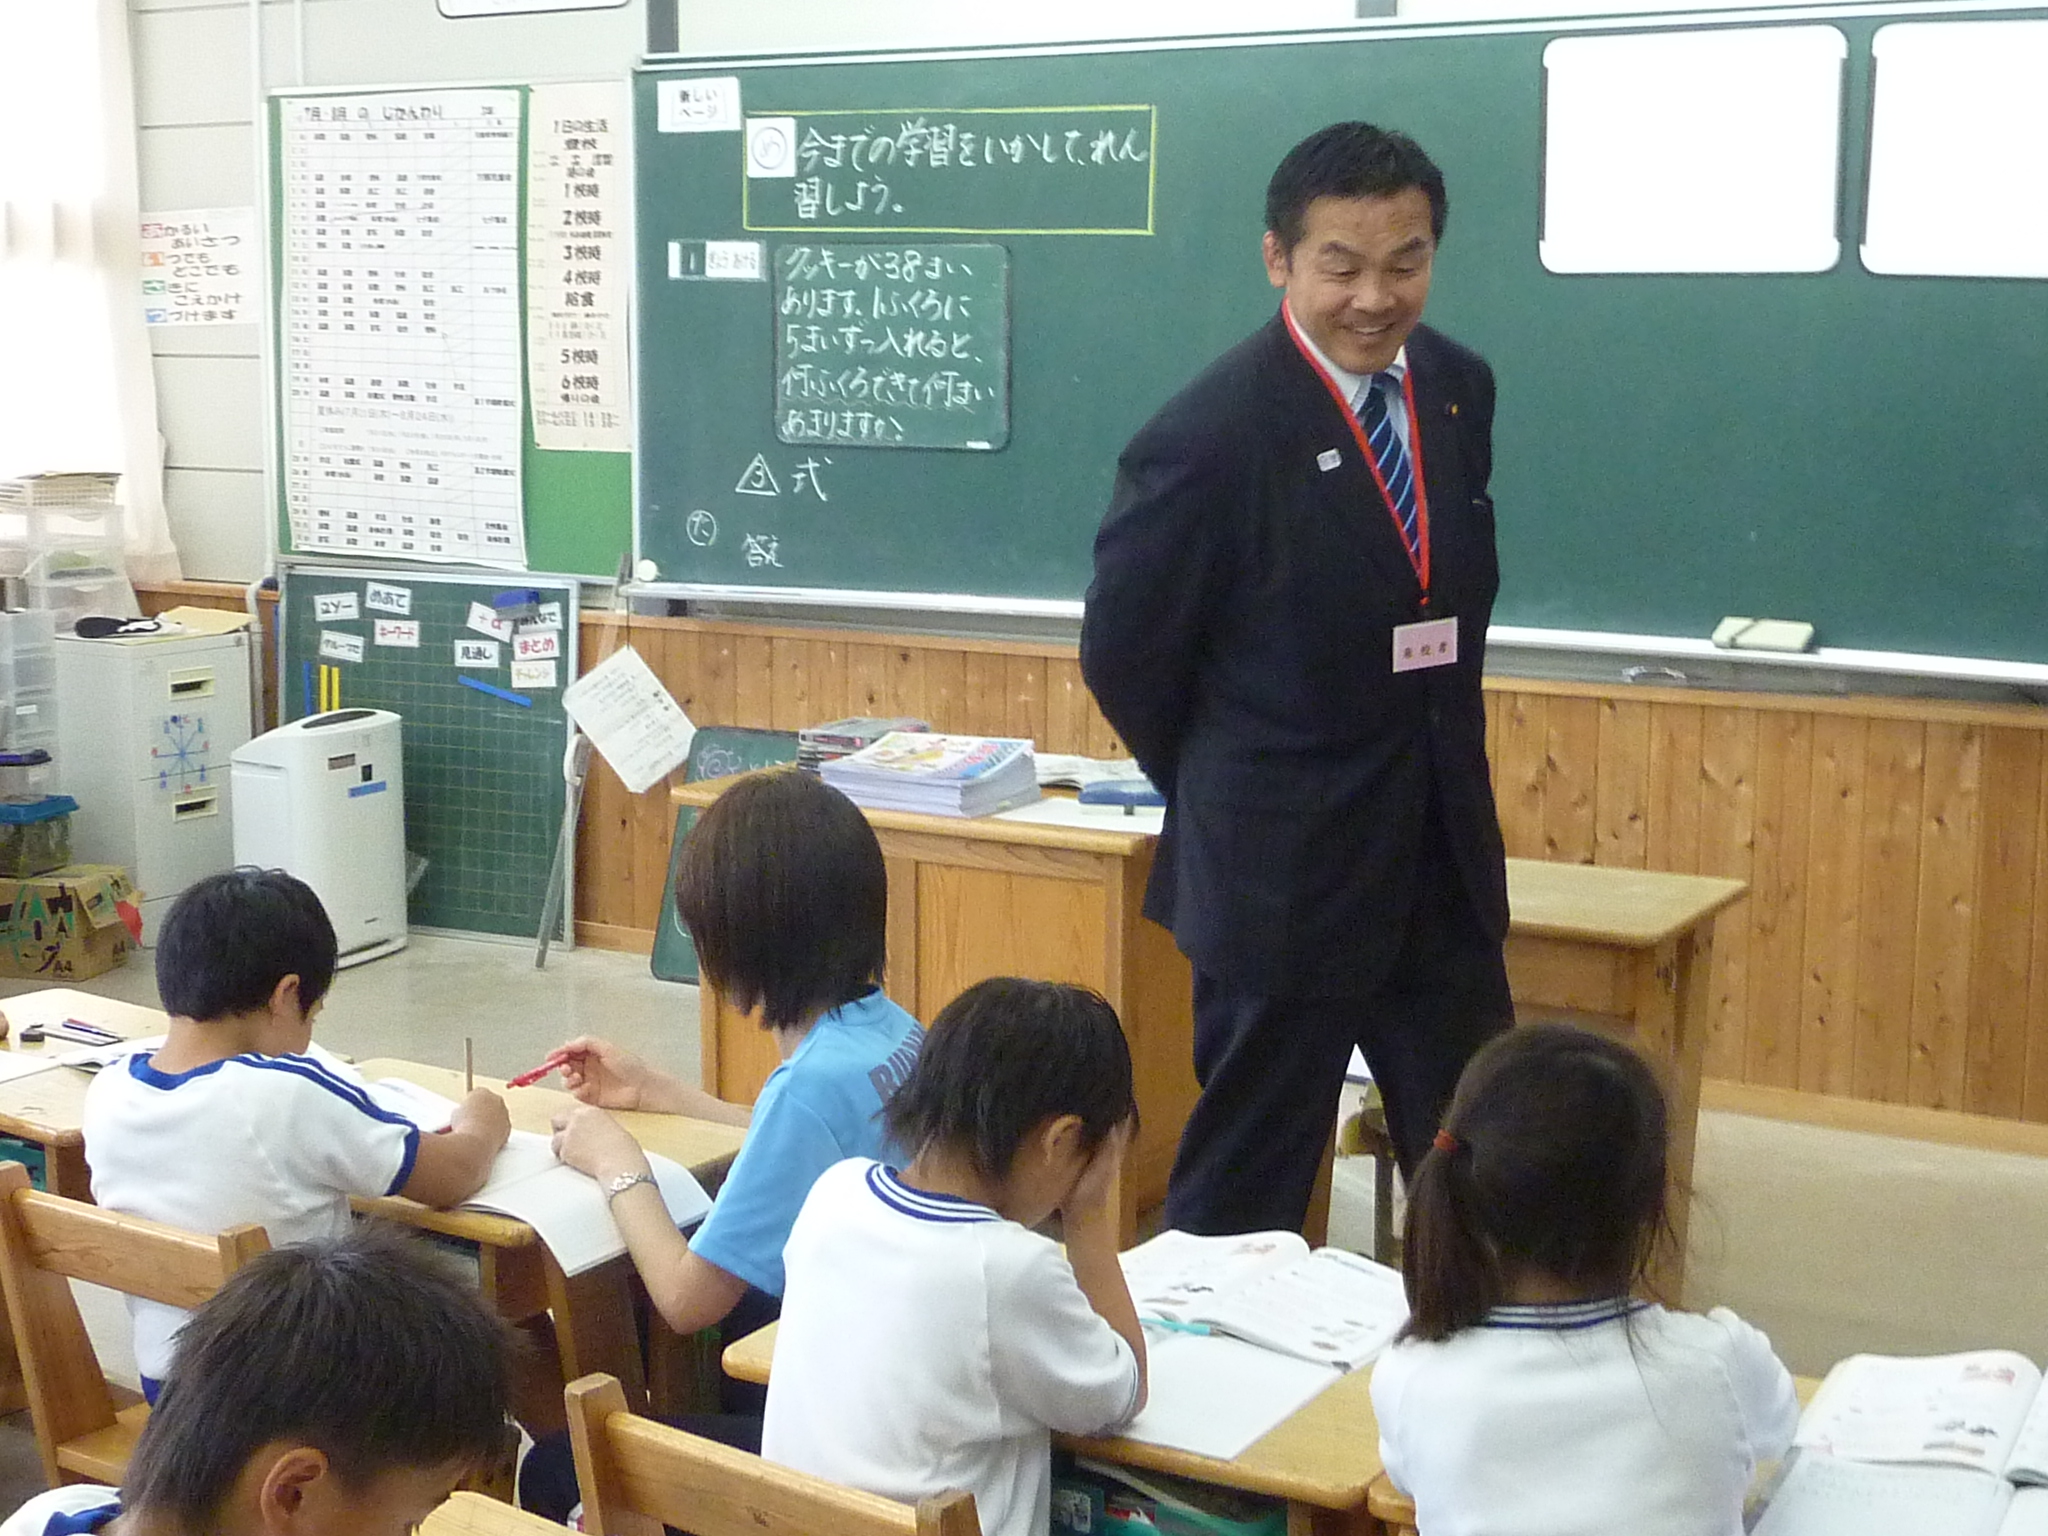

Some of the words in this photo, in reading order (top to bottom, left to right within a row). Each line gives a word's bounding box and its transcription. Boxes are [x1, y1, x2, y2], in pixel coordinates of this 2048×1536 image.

[679, 88, 718, 103] 新しい
[679, 105, 718, 119] ページ
[793, 176, 905, 220] 習しよう。
[171, 236, 241, 249] あいさつ
[173, 264, 241, 278] どこでも
[785, 247, 974, 283] クッキーが38まい
[174, 293, 243, 307] こえかけ
[786, 322, 984, 363] 5まいずつ入れると、
[781, 363, 995, 407] 何ふくろできて何まい
[790, 456, 834, 502] 式
[741, 532, 785, 568] 答え
[369, 588, 406, 608] めあて
[379, 625, 415, 638] キーワード
[461, 645, 493, 661] 見通し
[518, 637, 555, 655] まとめ
